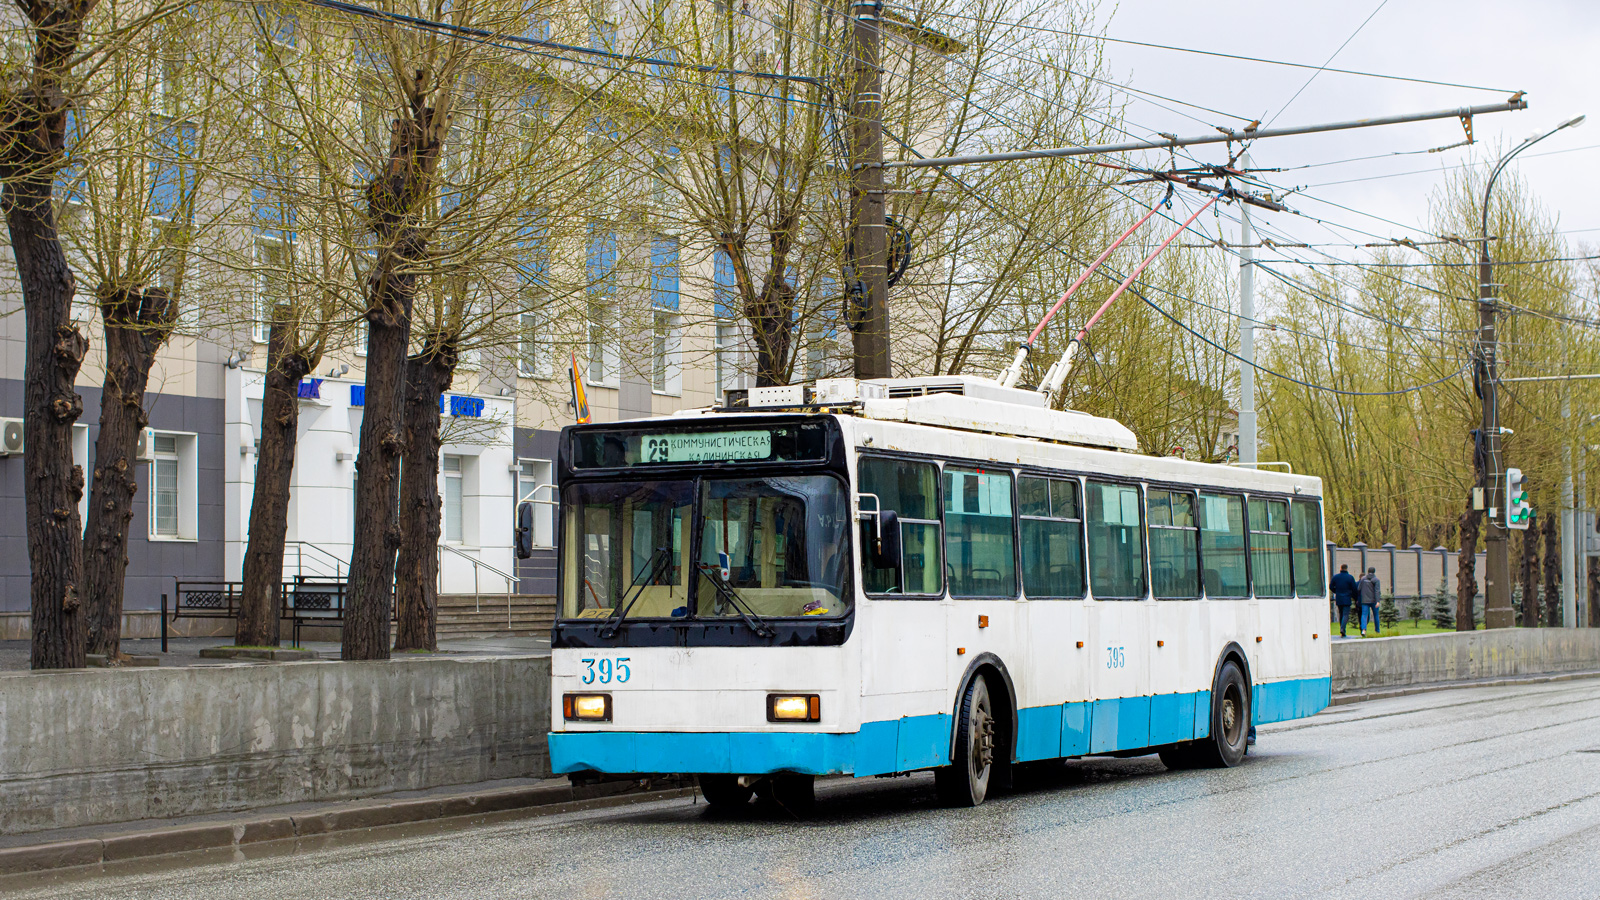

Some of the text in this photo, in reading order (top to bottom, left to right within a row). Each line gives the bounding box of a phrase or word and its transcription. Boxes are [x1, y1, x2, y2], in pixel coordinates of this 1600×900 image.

[648, 435, 771, 462] 29 КОММУНИСТИЧЕСКАЯ
[688, 450, 760, 461] КАЛИНИНСКАЯ
[1106, 646, 1125, 669] 395
[581, 657, 631, 684] 395
